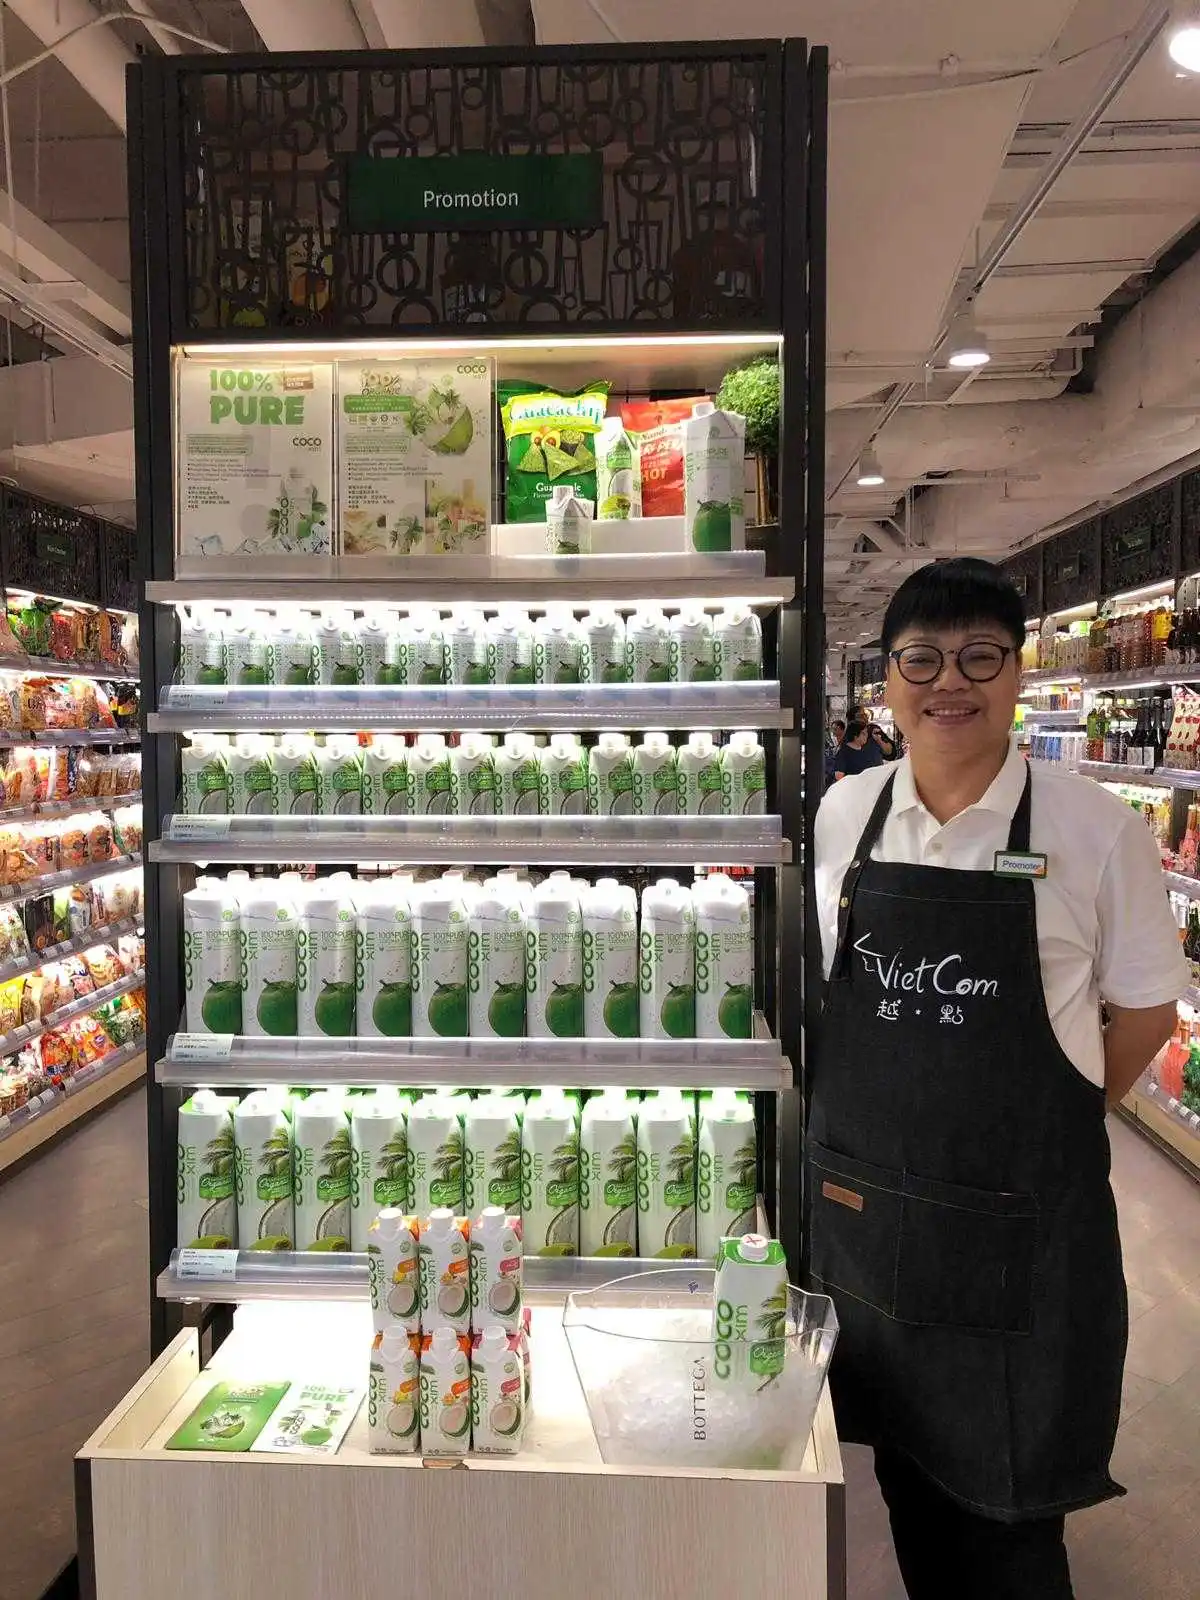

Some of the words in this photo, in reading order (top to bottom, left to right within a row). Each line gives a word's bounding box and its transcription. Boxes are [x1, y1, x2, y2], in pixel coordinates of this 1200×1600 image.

[423, 188, 519, 208] Promotion
[210, 370, 273, 392] 100%
[456, 365, 487, 375] COCO
[210, 395, 305, 425] PURE
[292, 436, 322, 447] COCO
[735, 1304, 748, 1342] xim
[714, 1299, 733, 1379] COCO
[693, 1355, 707, 1441] BOTTEGA
